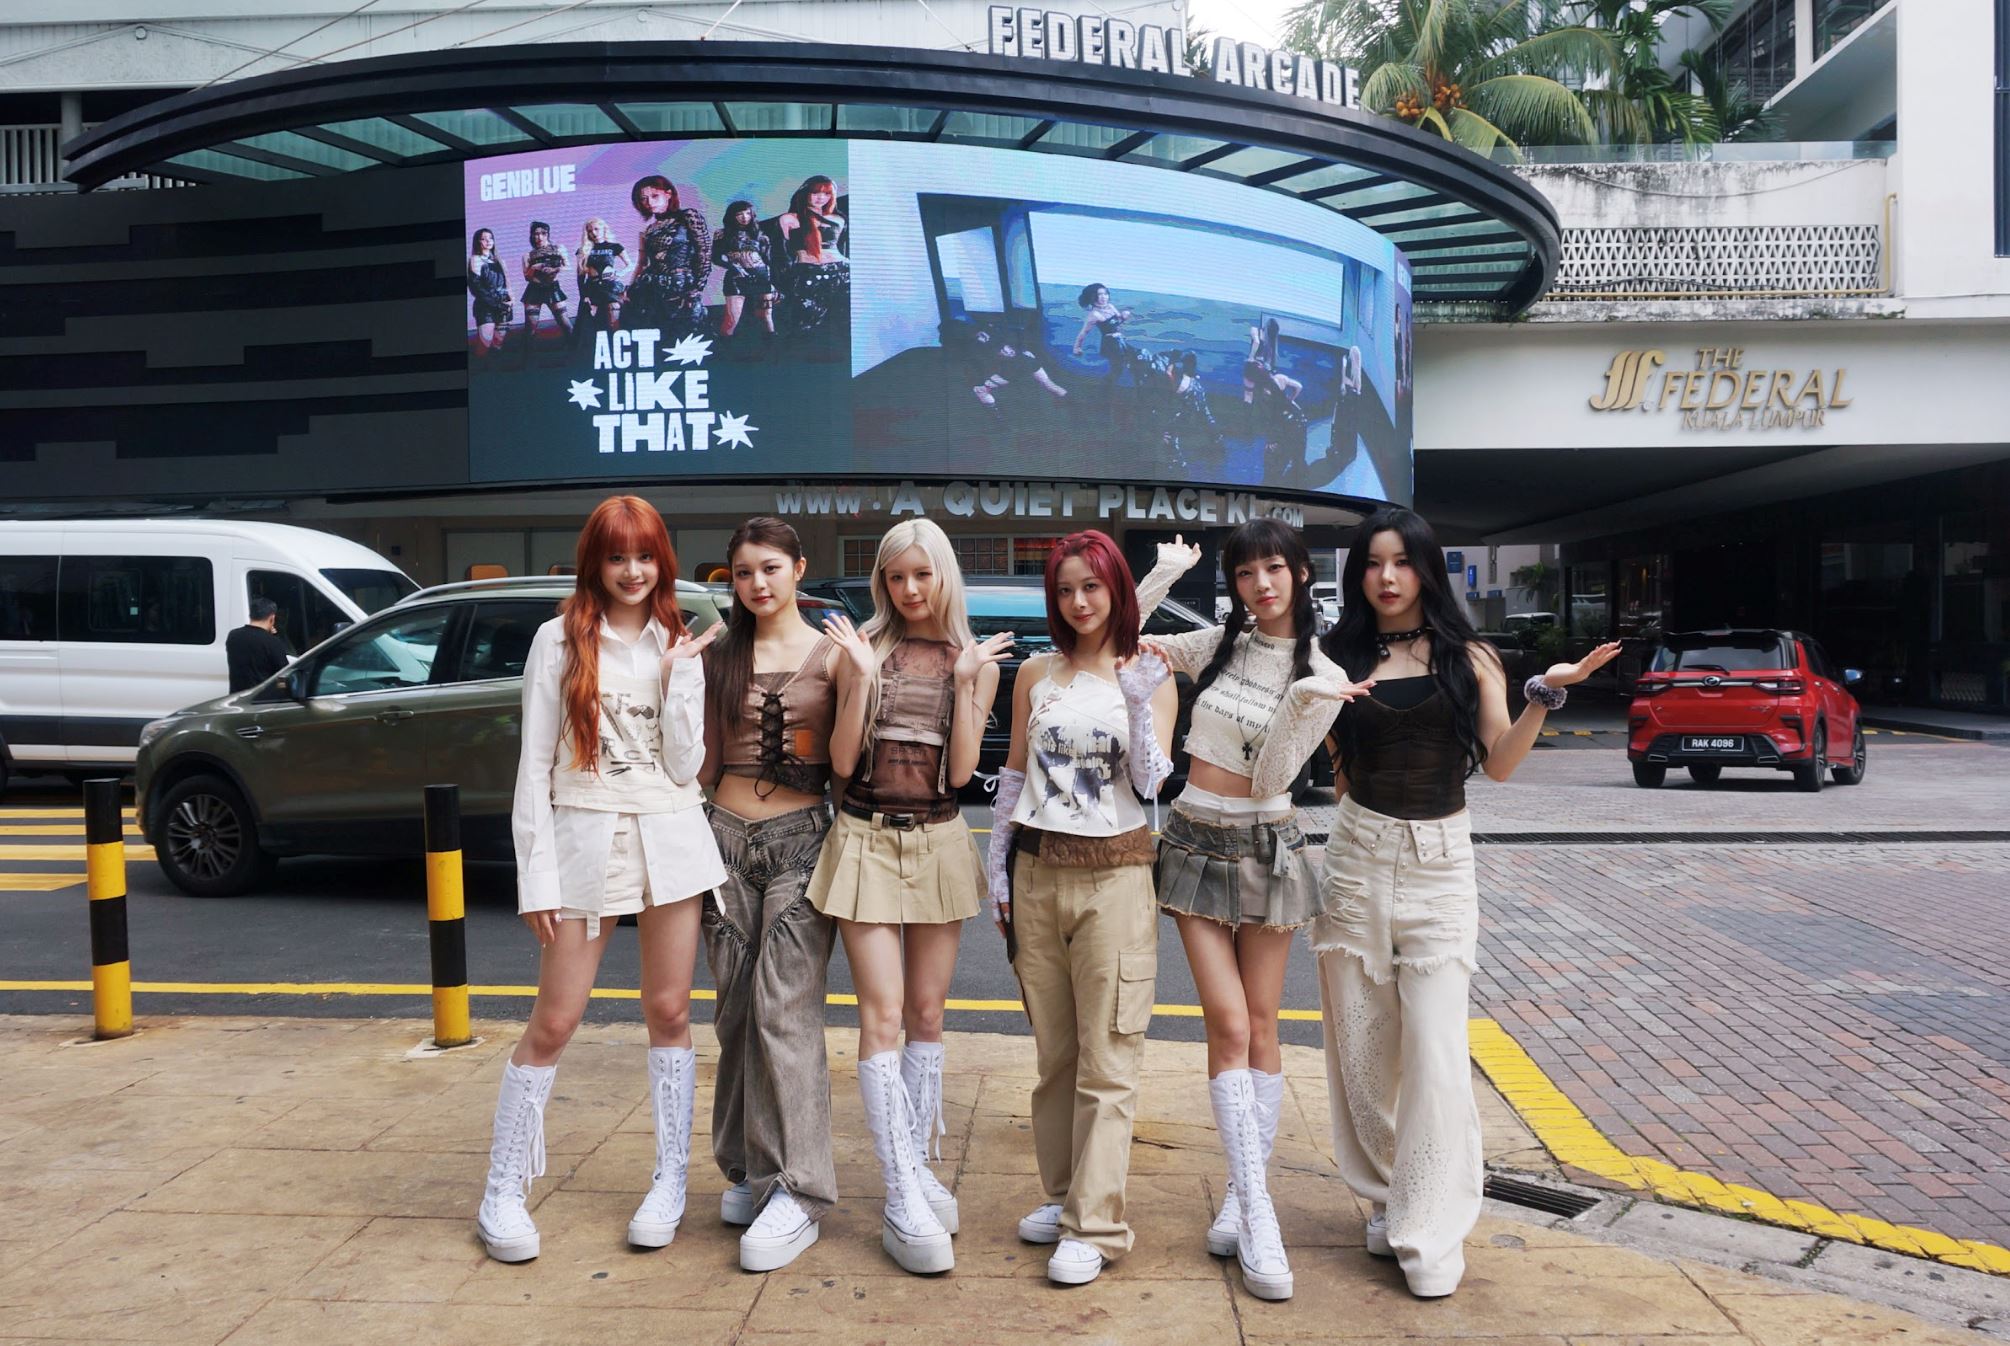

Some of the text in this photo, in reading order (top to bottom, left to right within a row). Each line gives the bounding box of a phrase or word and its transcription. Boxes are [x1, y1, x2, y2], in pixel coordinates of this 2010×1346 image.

[989, 5, 1360, 110] FEDERAL ARCADE
[480, 164, 576, 201] GENBLUE
[594, 328, 660, 370] ACT
[1697, 347, 1744, 370] THE
[608, 370, 709, 411] LIKE
[1657, 368, 1853, 410] FEDERAL
[592, 411, 716, 453] THAT
[1682, 407, 1826, 431] KUALA LUMPUR
[890, 481, 925, 516] A
[943, 480, 1084, 518] QUIET
[1100, 484, 1217, 522] PLACE
[1692, 738, 1735, 748] RAK 4096
